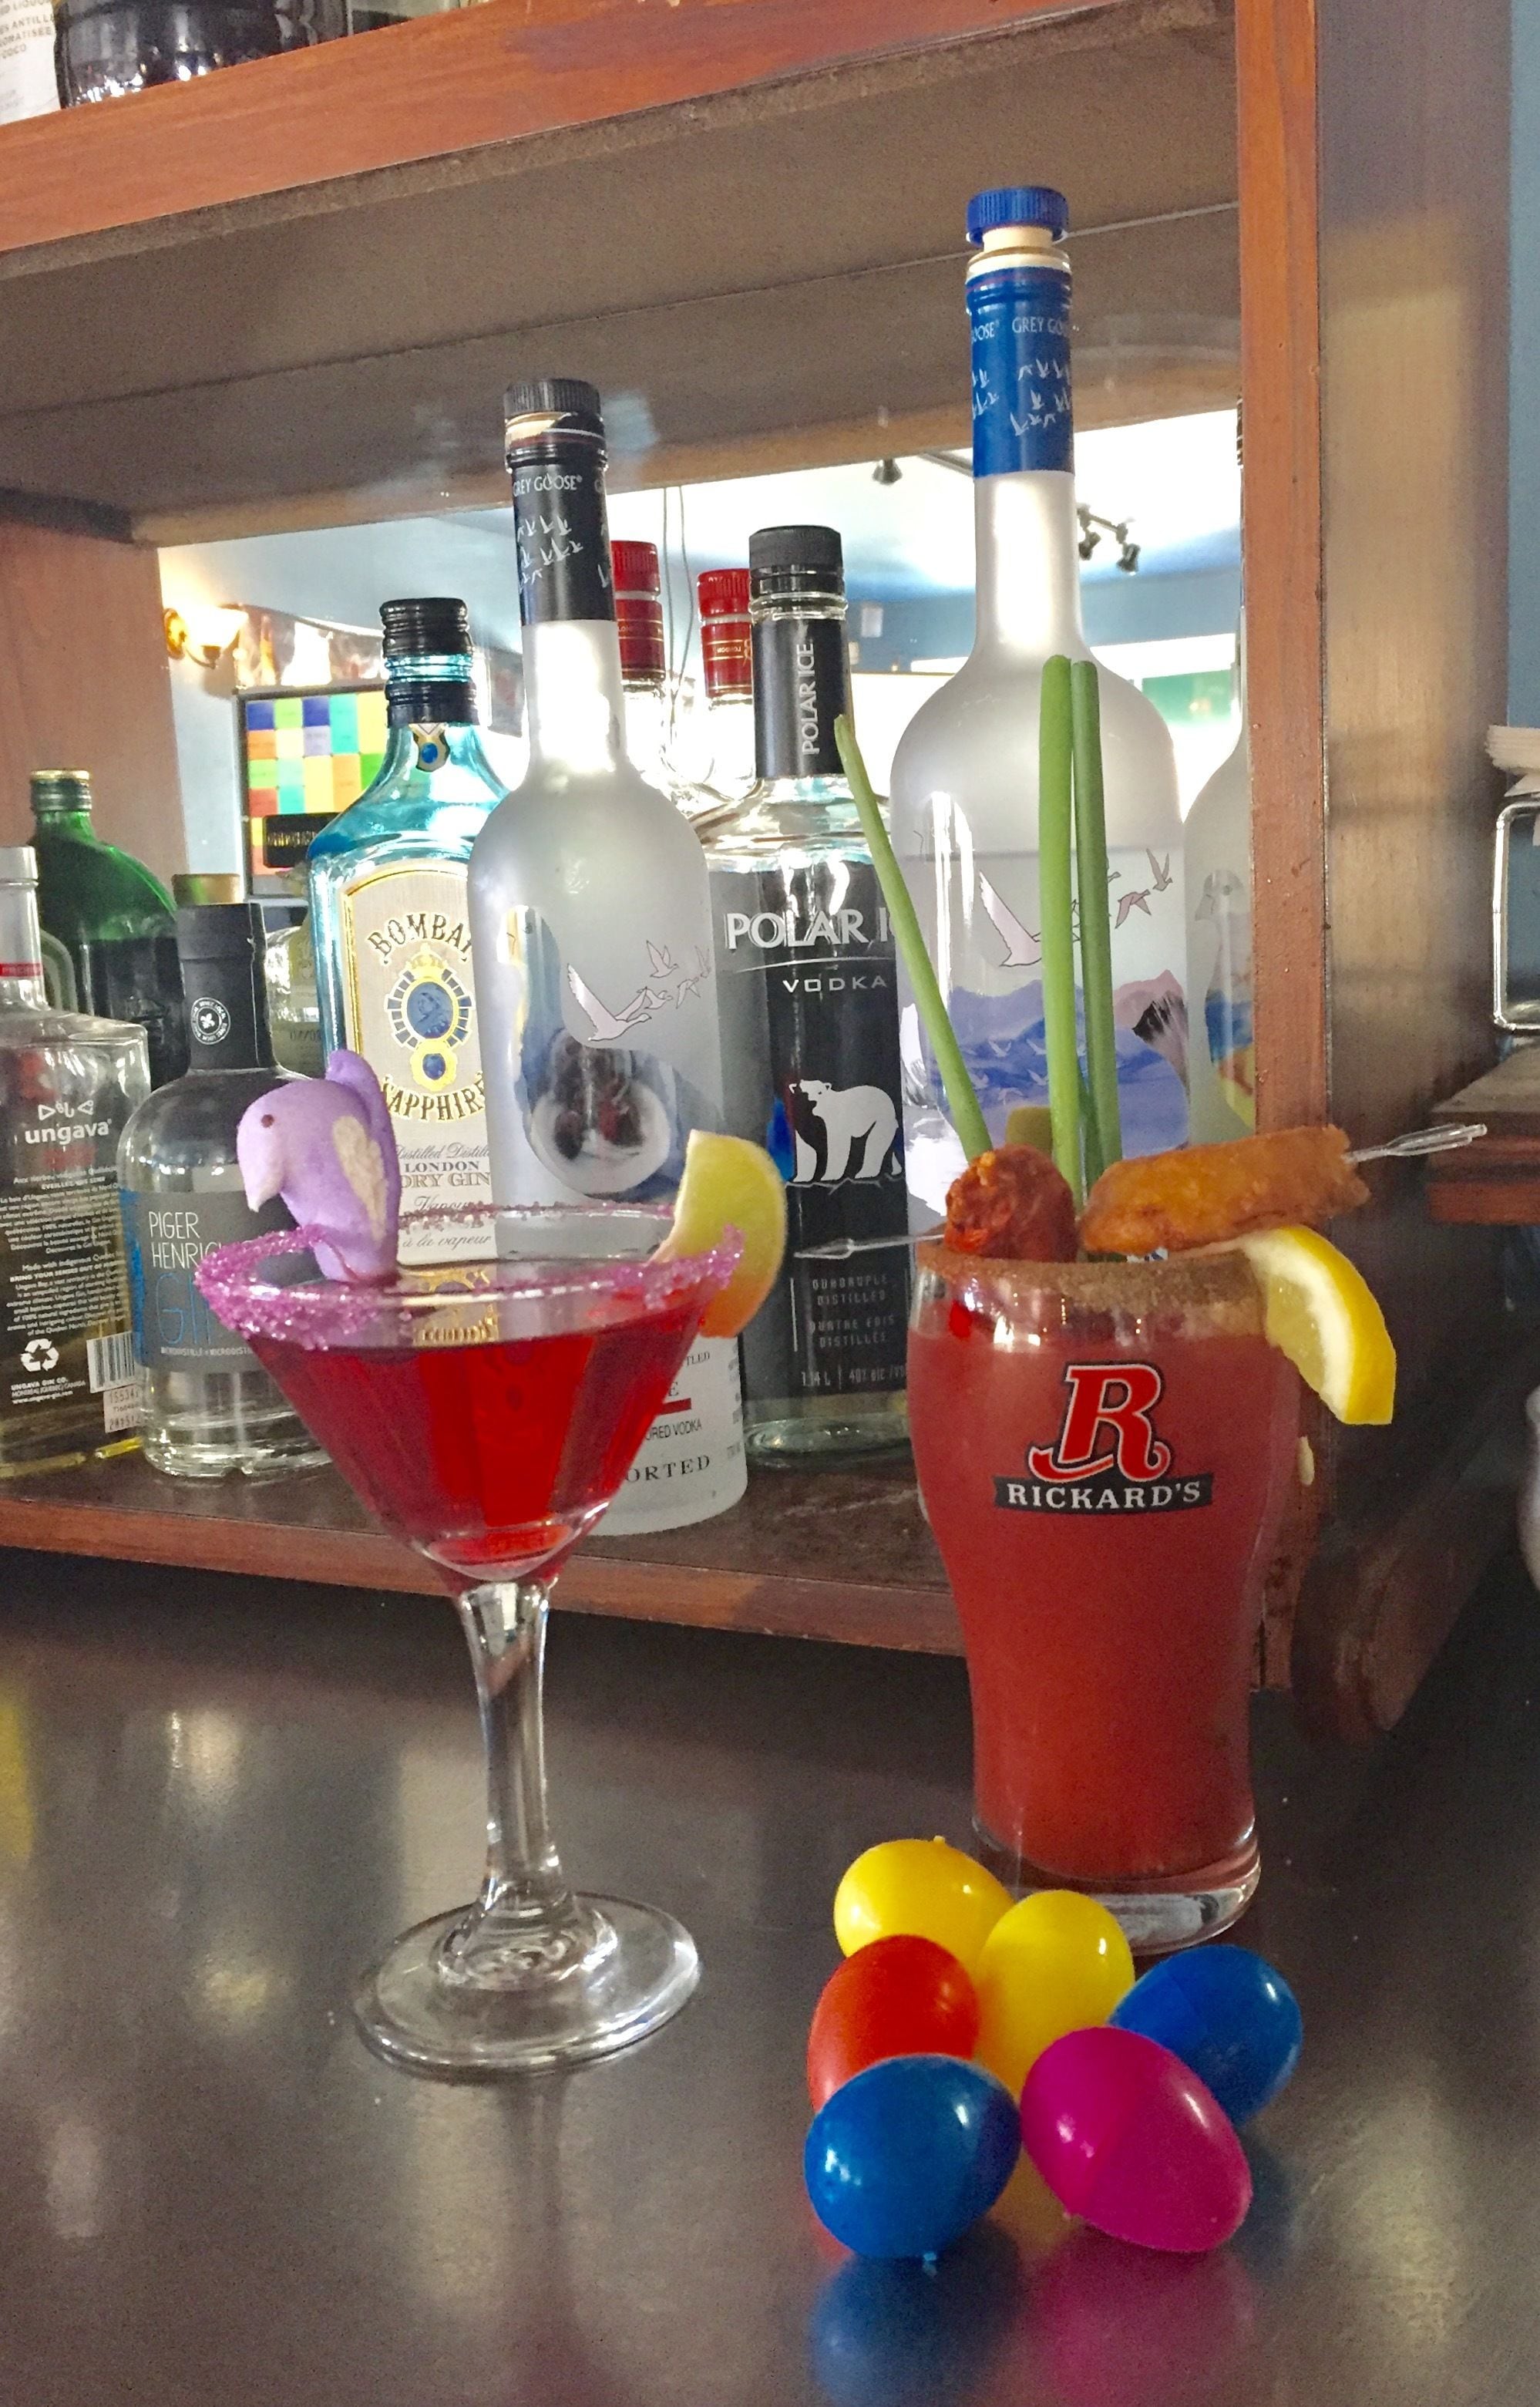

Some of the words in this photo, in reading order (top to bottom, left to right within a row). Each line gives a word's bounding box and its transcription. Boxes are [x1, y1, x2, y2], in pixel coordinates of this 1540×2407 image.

[12, 13, 54, 29] ANTILL
[1011, 315, 1044, 334] GREY
[513, 478, 532, 497] GREY
[533, 473, 578, 492] GOOSE
[796, 644, 815, 677] ICE
[799, 682, 820, 756] POLAR
[725, 908, 869, 950] POLAR
[782, 975, 887, 993] VODKA
[25, 1120, 110, 1146] ungava
[405, 1160, 479, 1173] LONDON
[400, 1173, 443, 1189] DRY
[447, 1171, 492, 1187] GIN
[149, 1210, 200, 1240] PIGER
[151, 1241, 222, 1270] HENRIC
[685, 1351, 711, 1367] TLED
[673, 1416, 703, 1436] VODKA
[624, 1454, 711, 1483] ORTED
[1006, 1480, 1201, 1510] RICKARD'S
